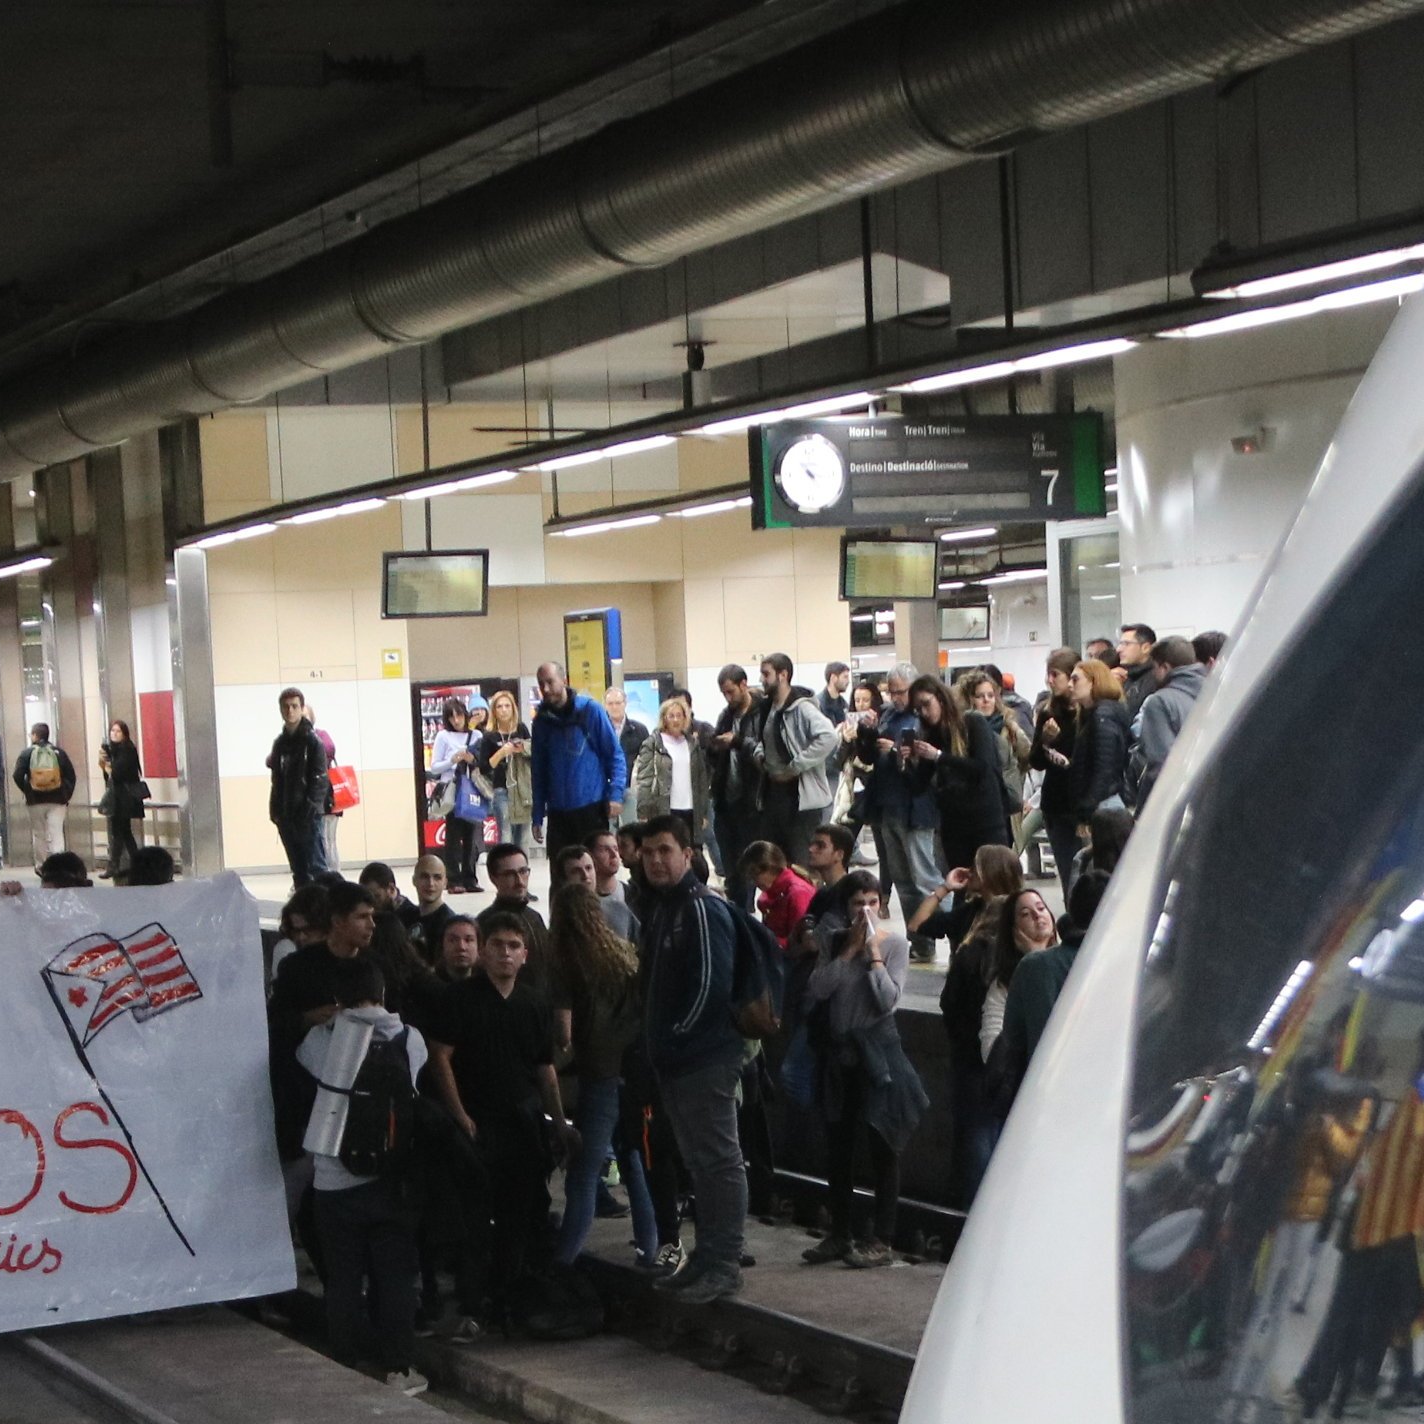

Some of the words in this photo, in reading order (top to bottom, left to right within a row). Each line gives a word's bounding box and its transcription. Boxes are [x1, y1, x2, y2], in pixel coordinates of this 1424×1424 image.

[849, 426, 870, 438] Hora
[904, 425, 924, 437] Tren
[928, 424, 948, 436] Tren
[850, 462, 883, 473] Destino
[888, 459, 934, 473] Destinació
[1040, 469, 1059, 506] 7
